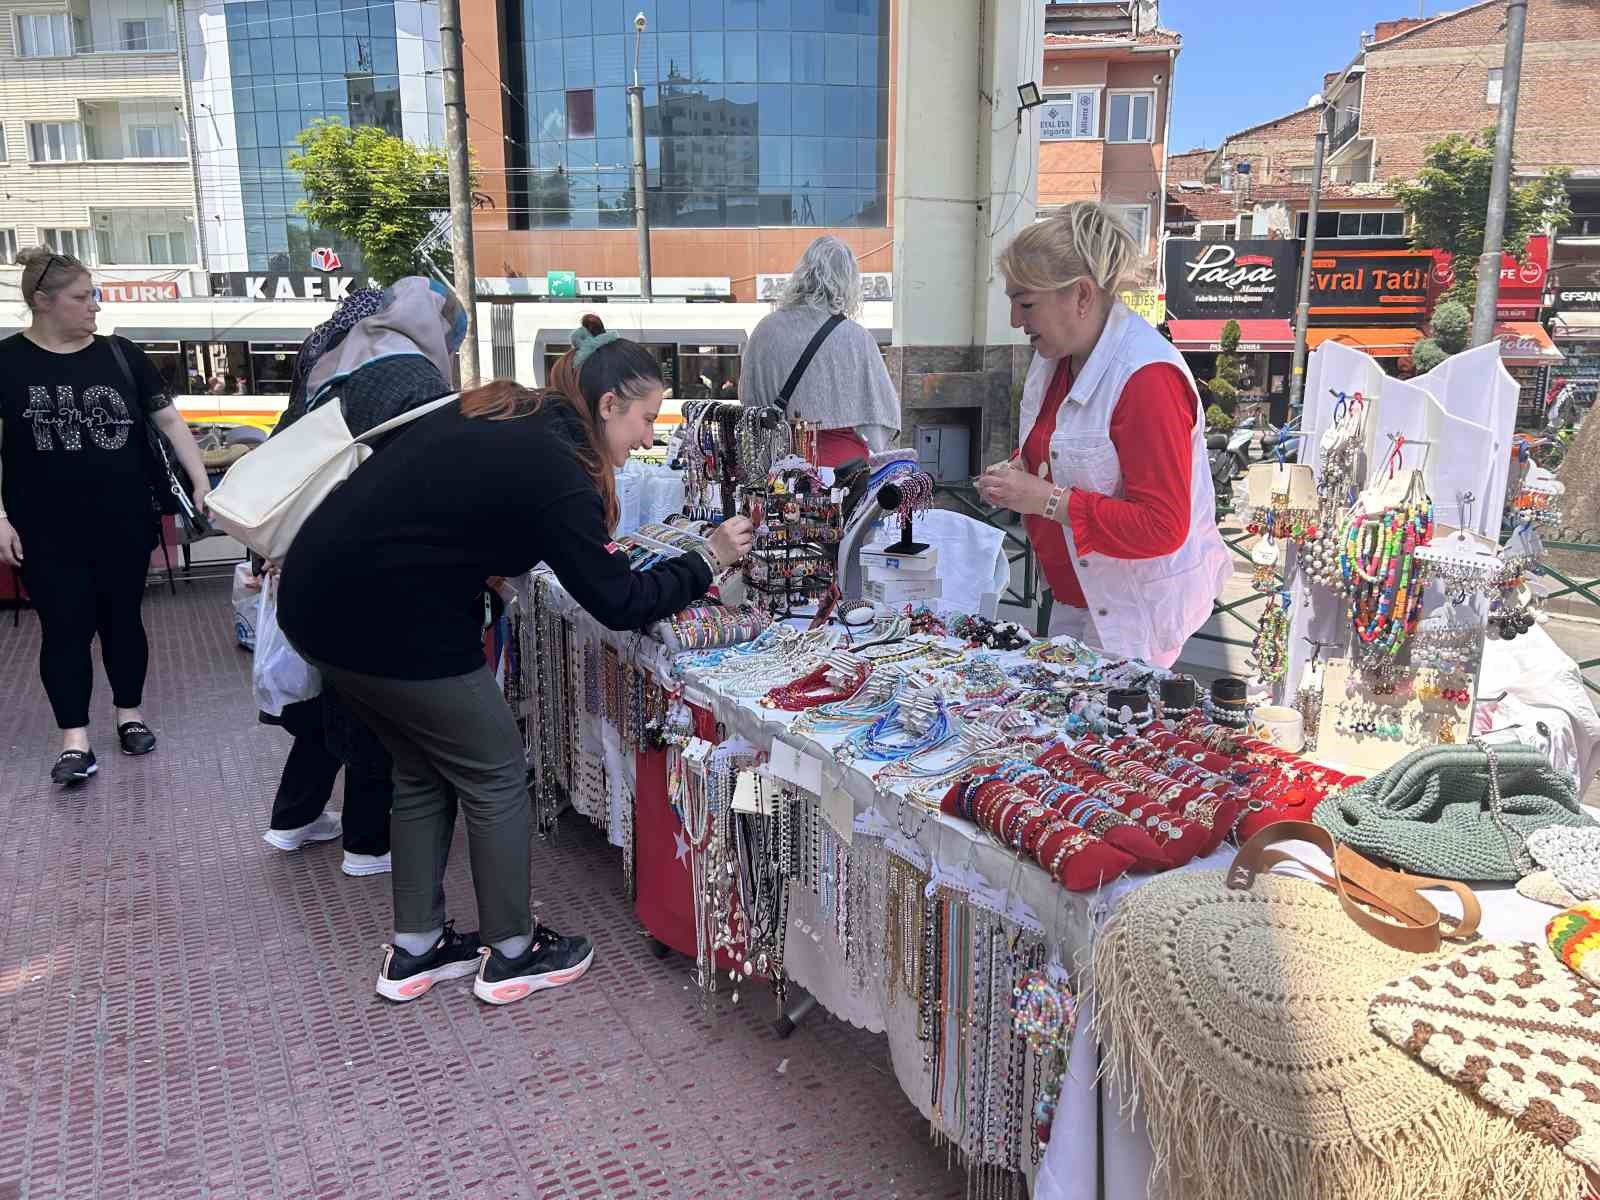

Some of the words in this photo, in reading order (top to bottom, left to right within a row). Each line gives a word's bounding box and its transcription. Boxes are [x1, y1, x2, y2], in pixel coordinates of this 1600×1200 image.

[1185, 245, 1277, 289] Paşa
[245, 277, 354, 300] KAFK
[584, 280, 614, 292] TEB
[27, 385, 129, 451] NO
